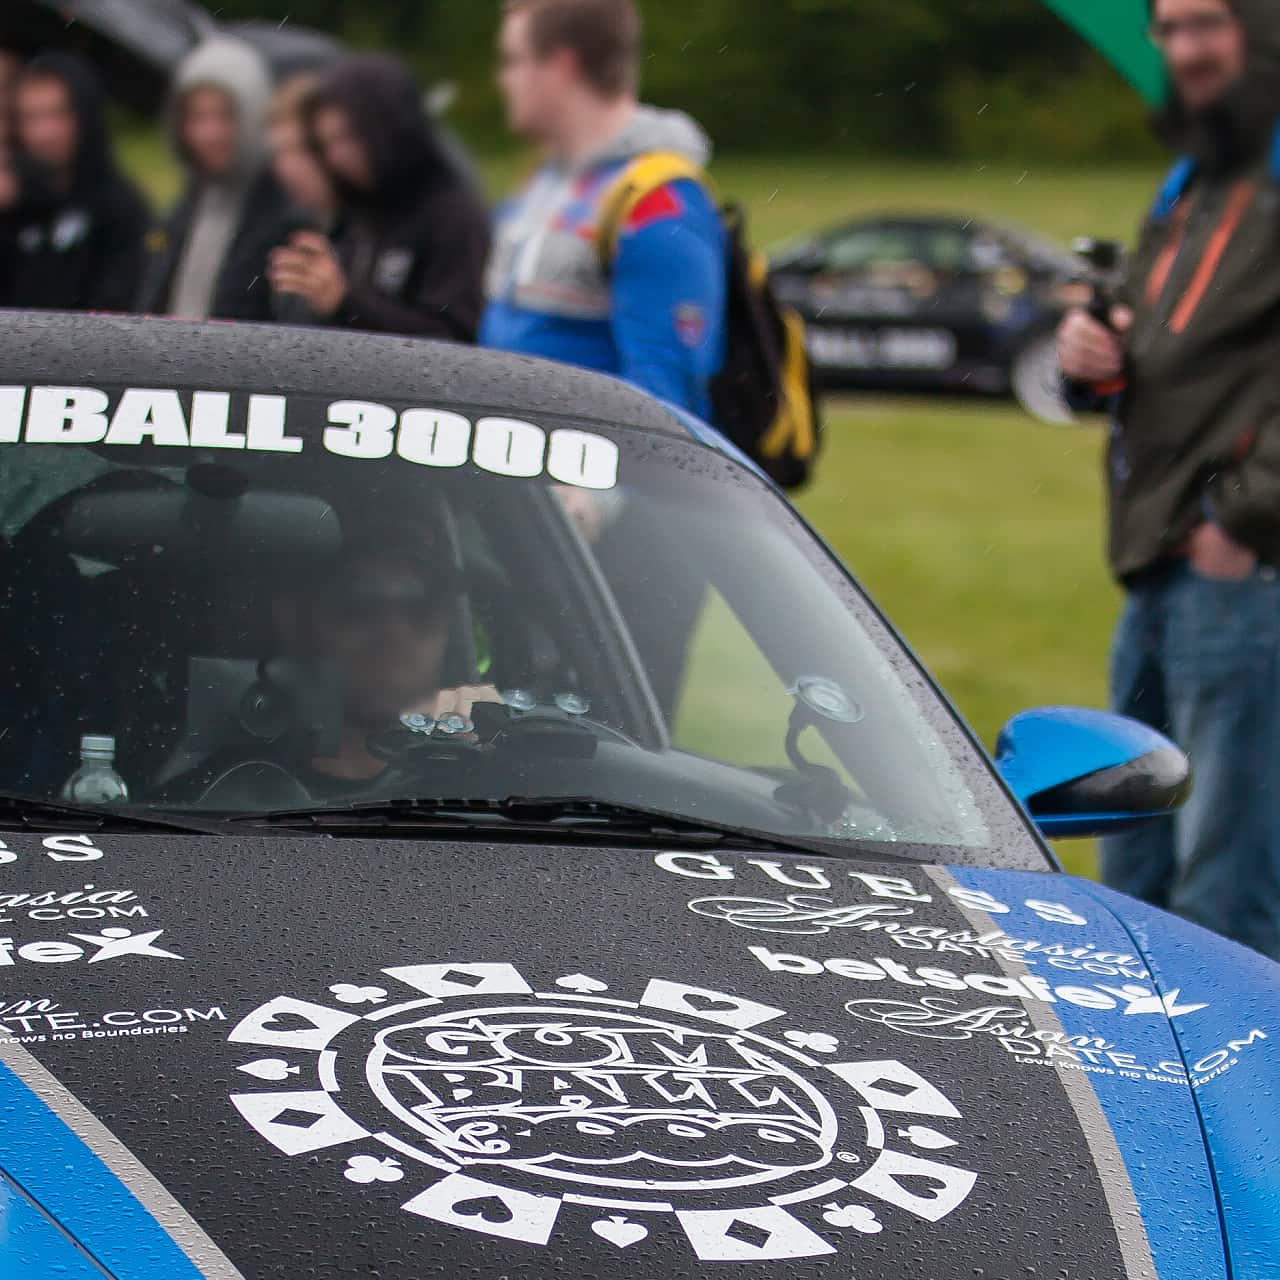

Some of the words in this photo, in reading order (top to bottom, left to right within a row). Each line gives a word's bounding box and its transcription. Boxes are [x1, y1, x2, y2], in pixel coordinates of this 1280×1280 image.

[322, 399, 619, 490] 3000
[654, 852, 1087, 926] GUESS
[687, 895, 1140, 966] Anastasia
[747, 946, 1117, 1010] betsafe
[52, 1030, 76, 1041] no
[82, 1024, 189, 1039] Boundaries
[844, 996, 1116, 1050] Asian
[998, 1028, 1269, 1077] DATE.COM
[1015, 1054, 1055, 1068] Love
[1059, 1060, 1116, 1076] Knows
[1119, 1069, 1142, 1080] no
